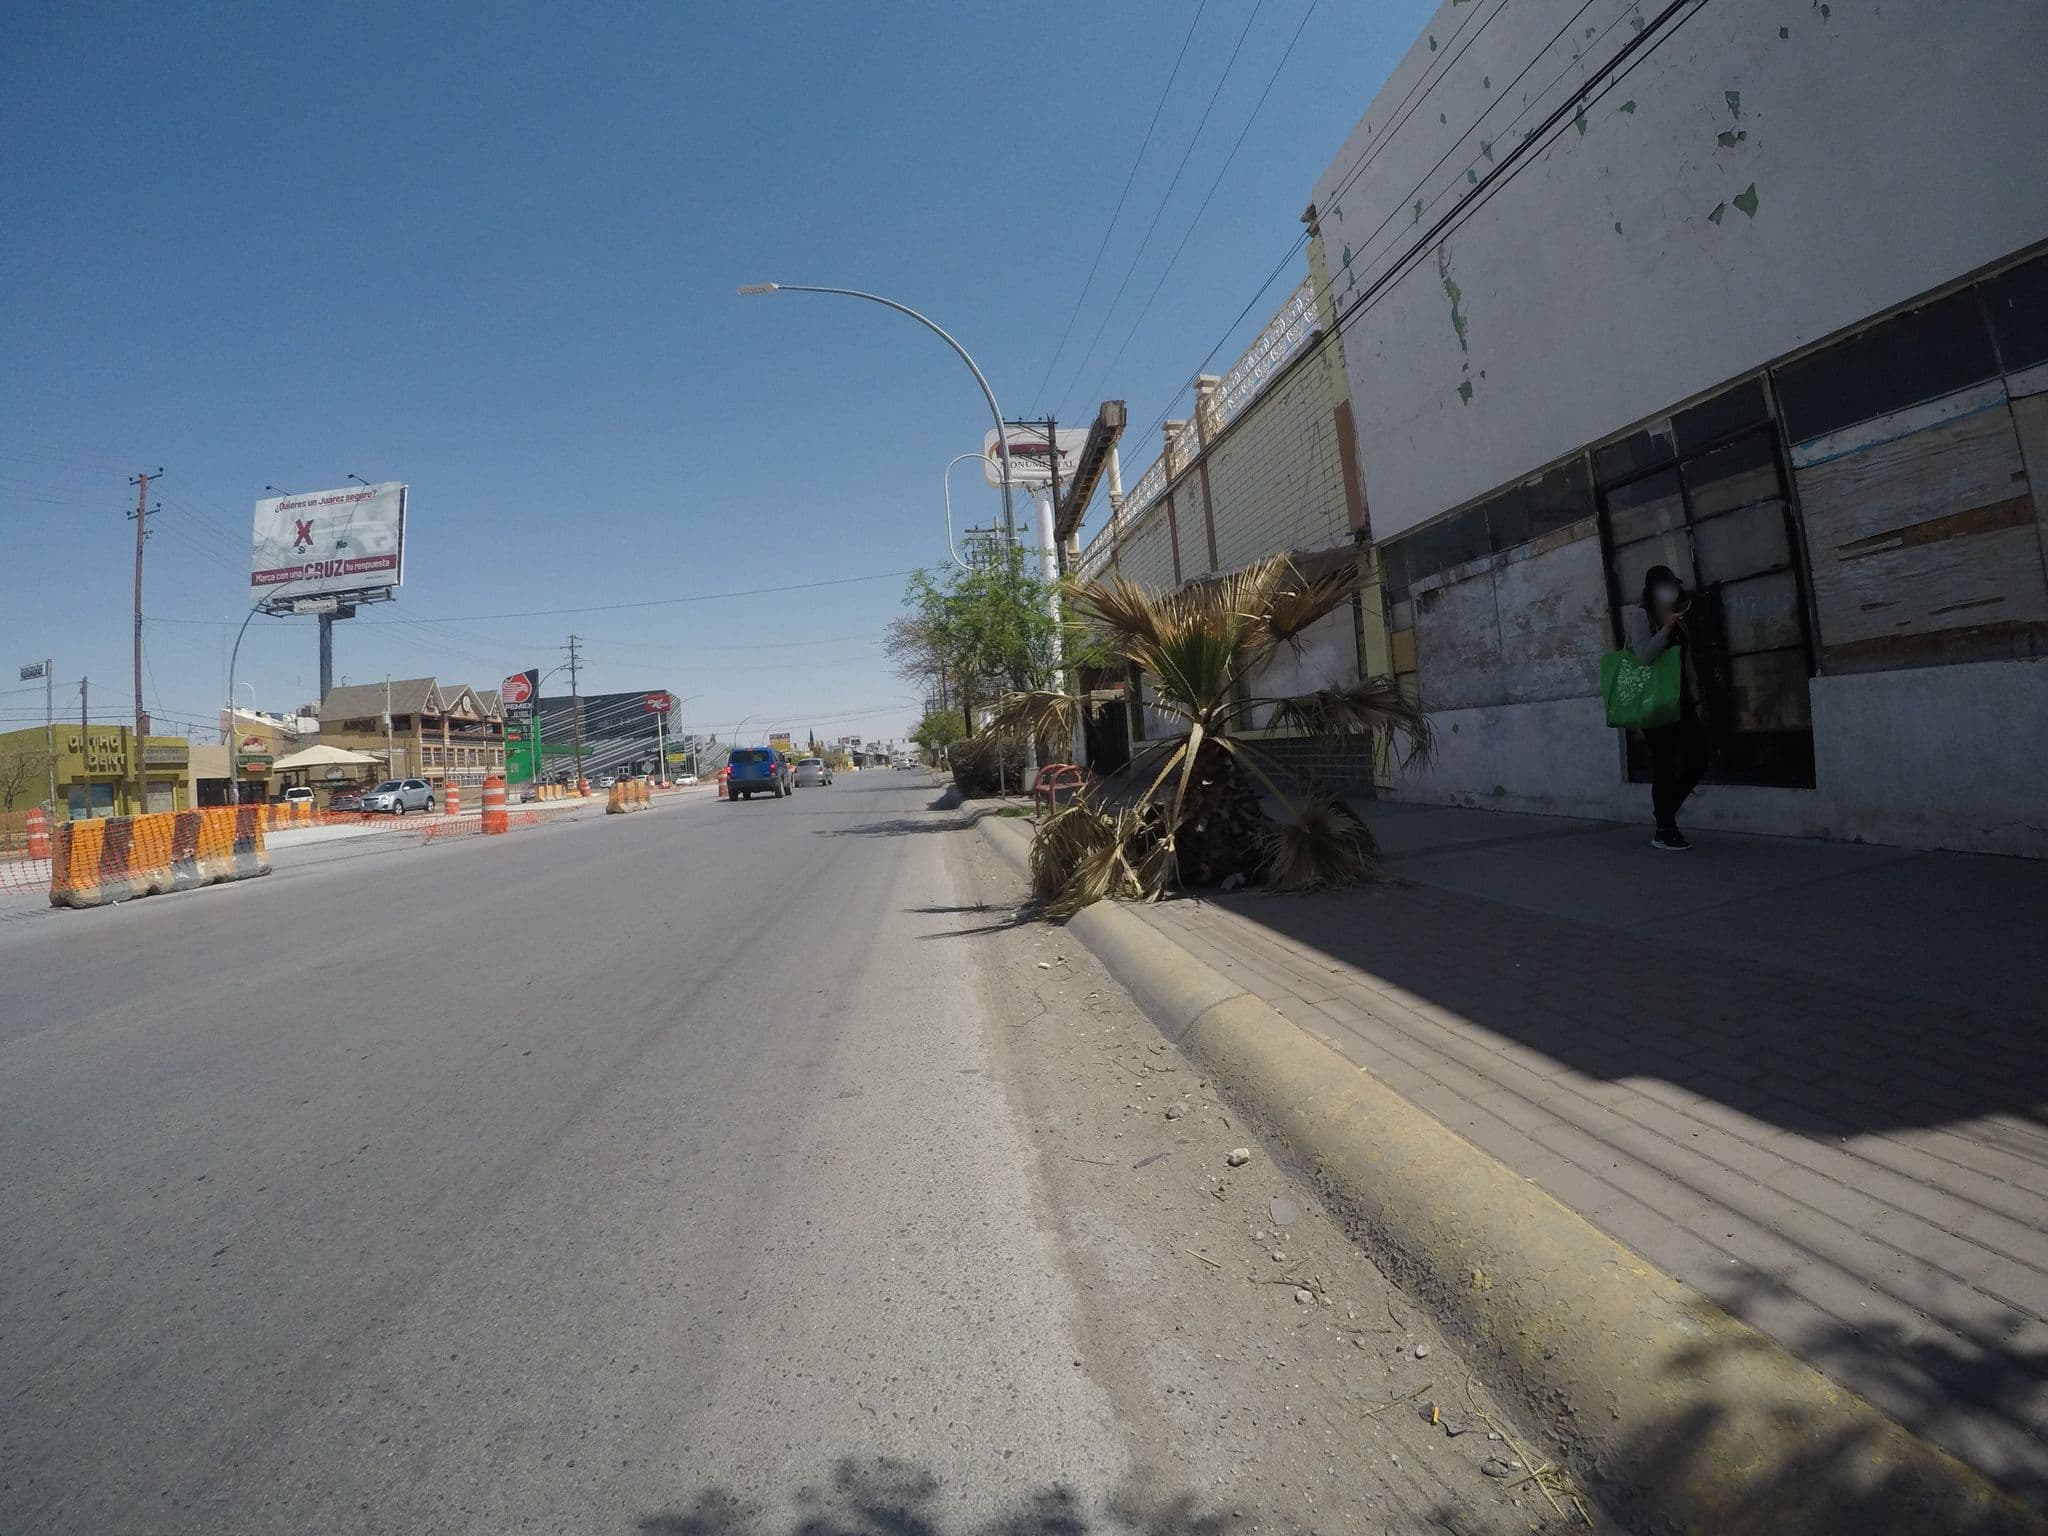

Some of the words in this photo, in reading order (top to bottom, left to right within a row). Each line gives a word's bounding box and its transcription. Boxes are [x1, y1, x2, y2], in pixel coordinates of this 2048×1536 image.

[275, 500, 306, 513] ¿Quieres
[307, 499, 318, 507] un
[319, 495, 344, 505] Juárez
[345, 489, 377, 502] seguro?
[336, 539, 347, 549] No
[255, 573, 275, 583] Marca
[276, 572, 289, 581] con
[289, 571, 302, 579] una
[304, 559, 343, 580] CRUZ
[346, 562, 354, 570] tu
[354, 559, 390, 571] respuesta
